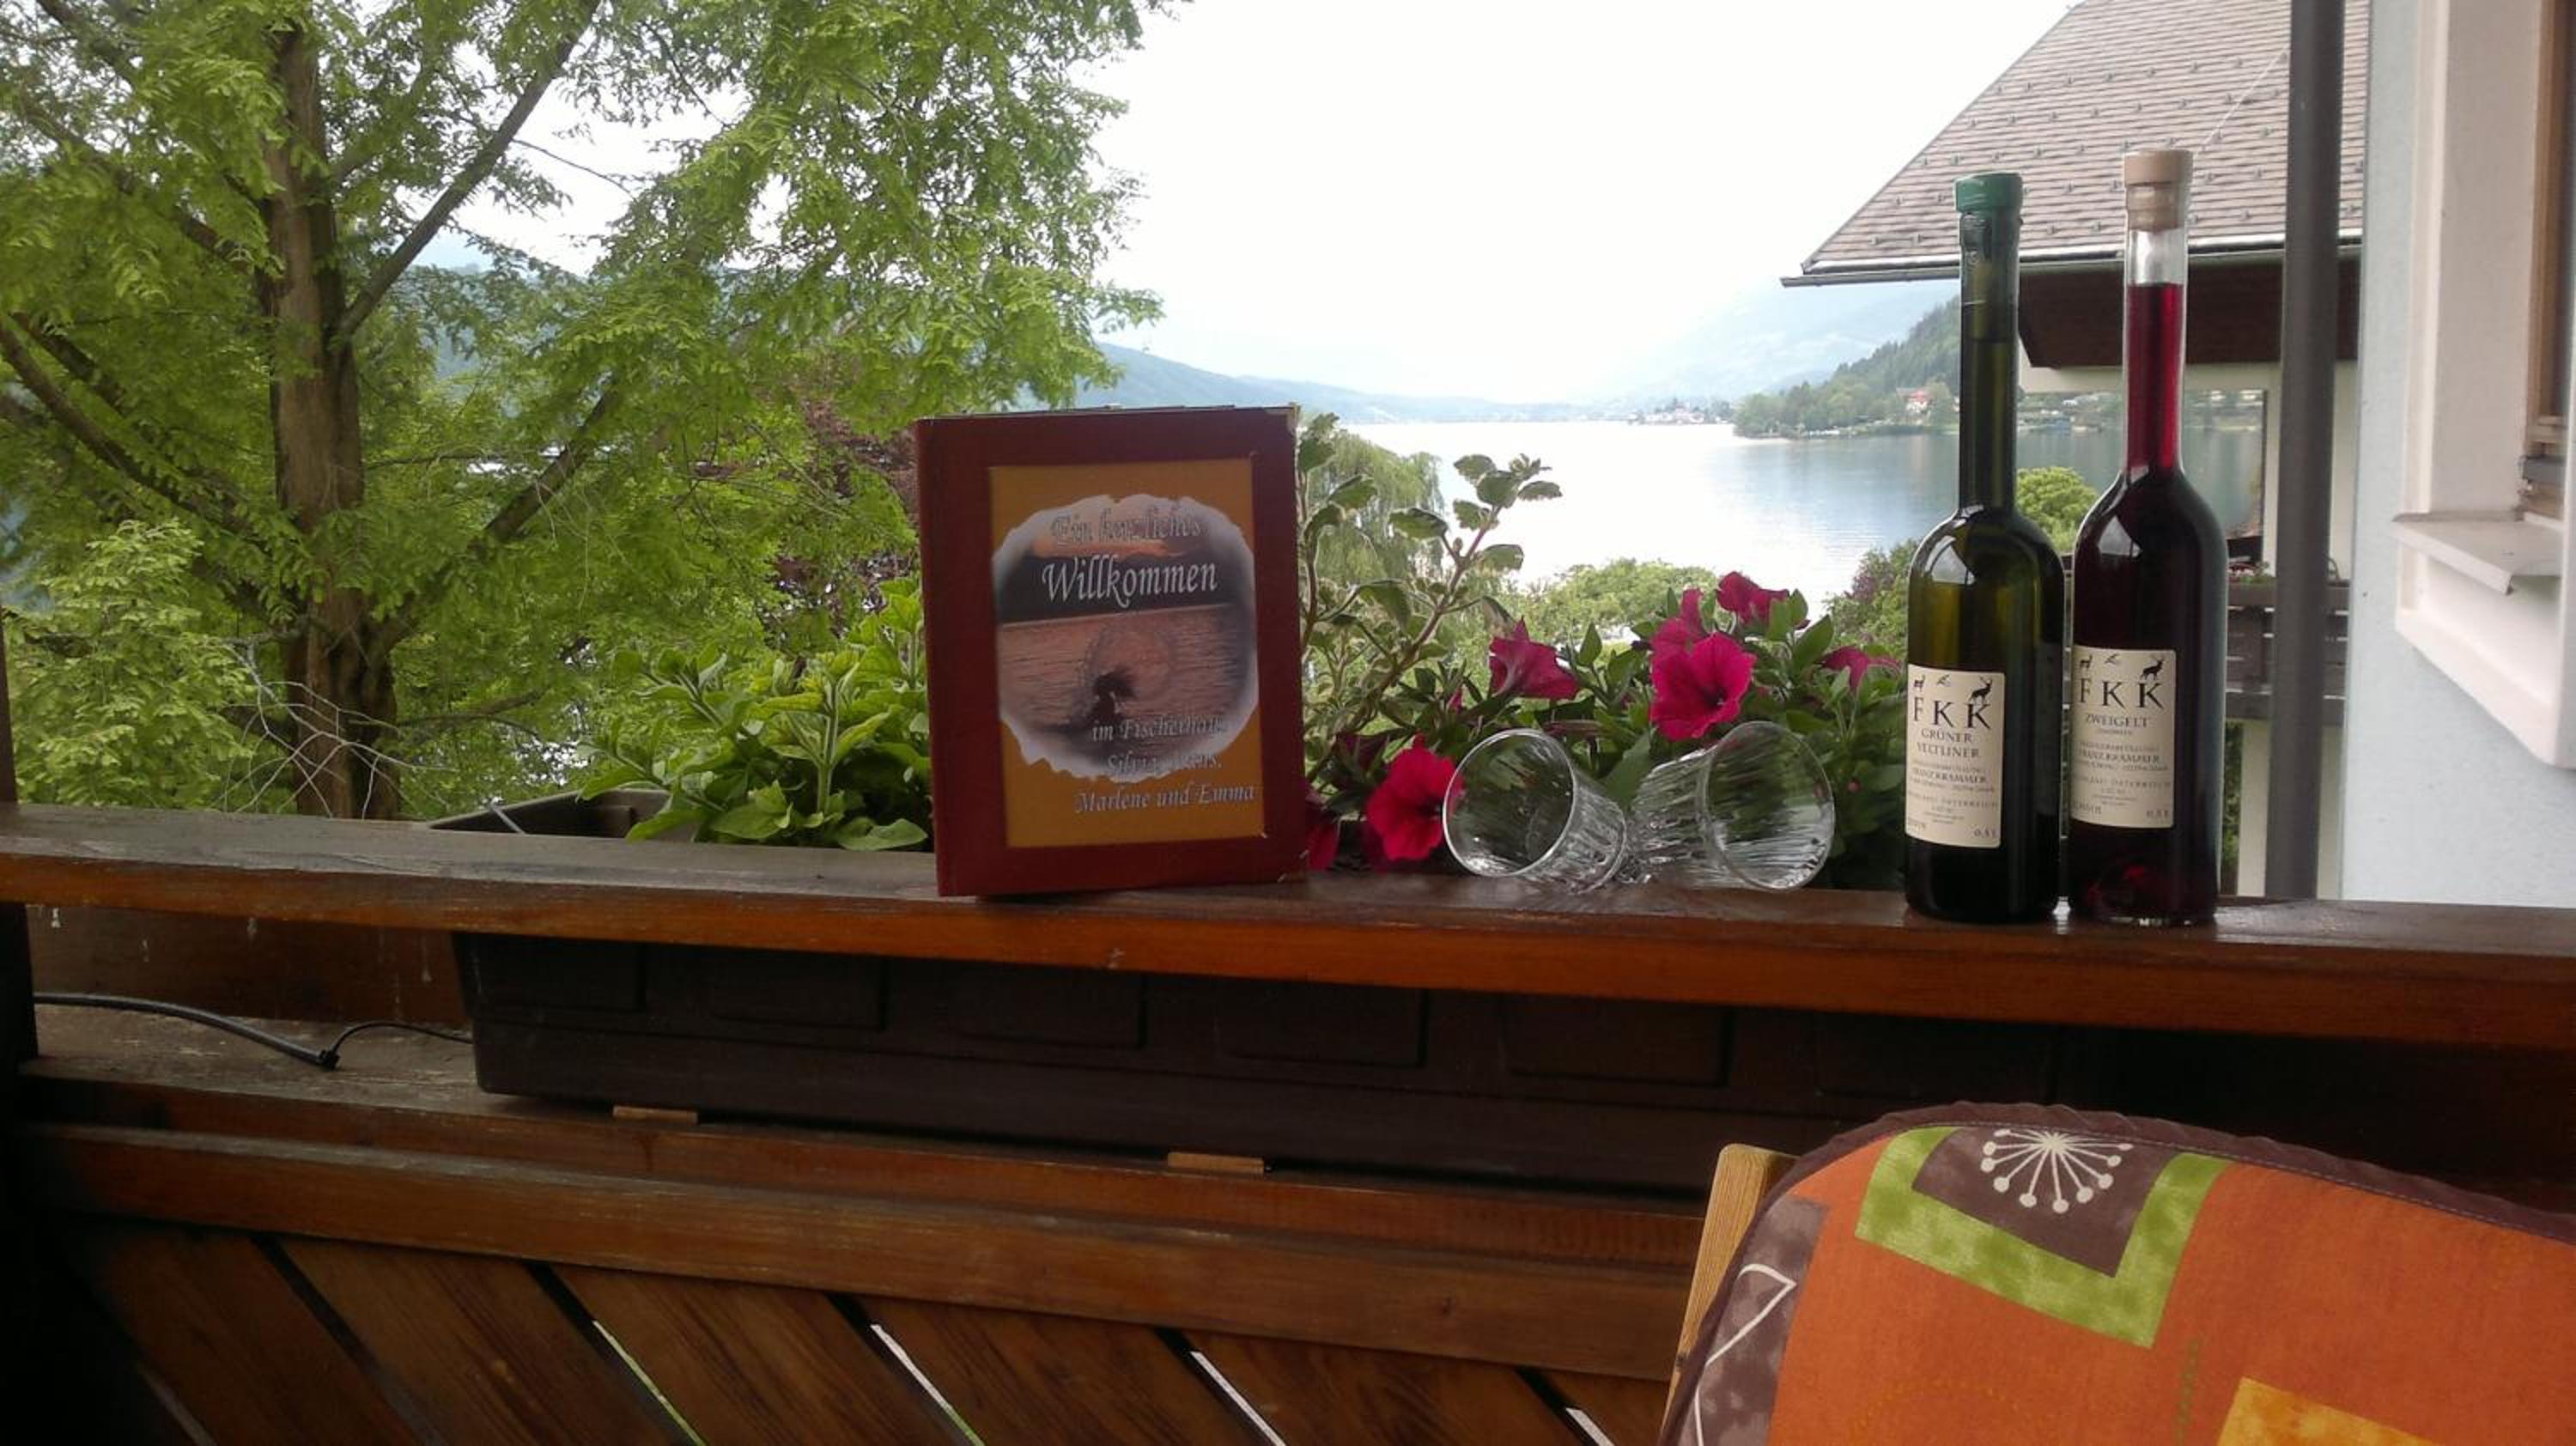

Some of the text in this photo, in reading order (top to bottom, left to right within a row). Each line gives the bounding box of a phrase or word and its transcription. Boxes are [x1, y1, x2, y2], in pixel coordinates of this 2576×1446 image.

[1050, 505, 1204, 543] Ein herzliches
[1042, 554, 1218, 609] Willkommen
[1091, 720, 1114, 742] im
[2086, 713, 2151, 728] ZWEIGELT
[1921, 728, 1974, 744] GRÜNER
[1917, 741, 1980, 757] VELTLINER
[1075, 781, 1255, 813] Marlene und Emma
